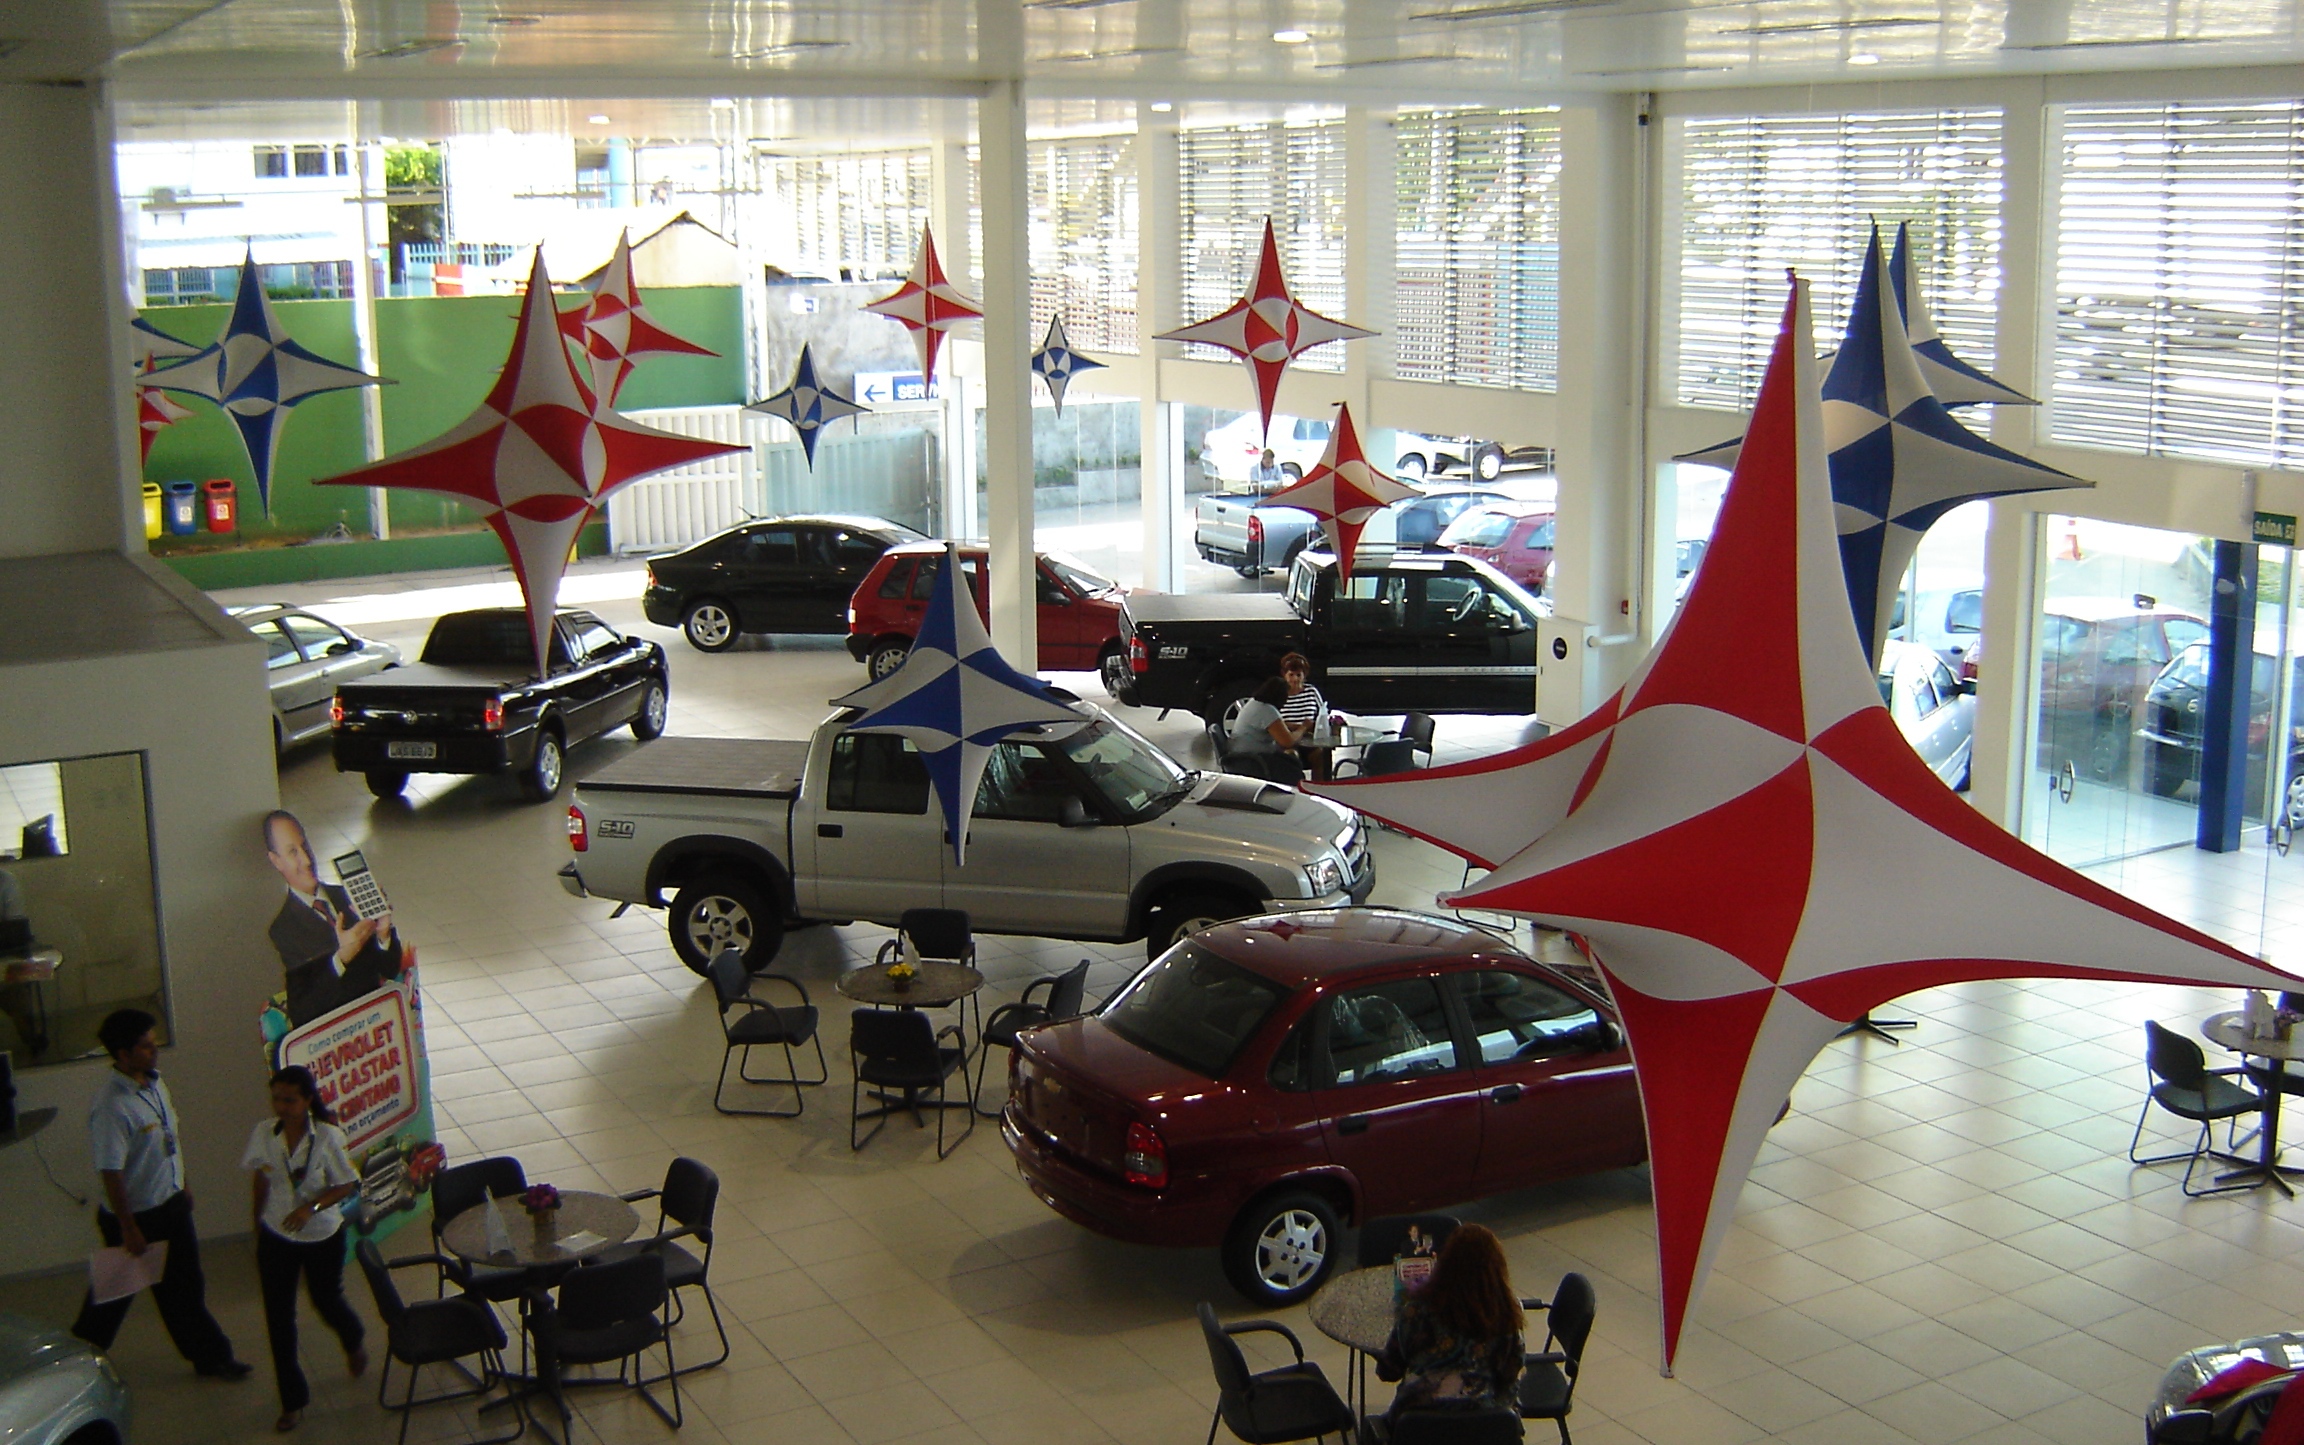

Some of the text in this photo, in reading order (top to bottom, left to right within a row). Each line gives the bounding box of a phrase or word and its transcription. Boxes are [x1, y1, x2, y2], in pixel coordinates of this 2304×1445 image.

[308, 1012, 381, 1055] Como comprar um
[339, 1046, 402, 1095] GASTAR
